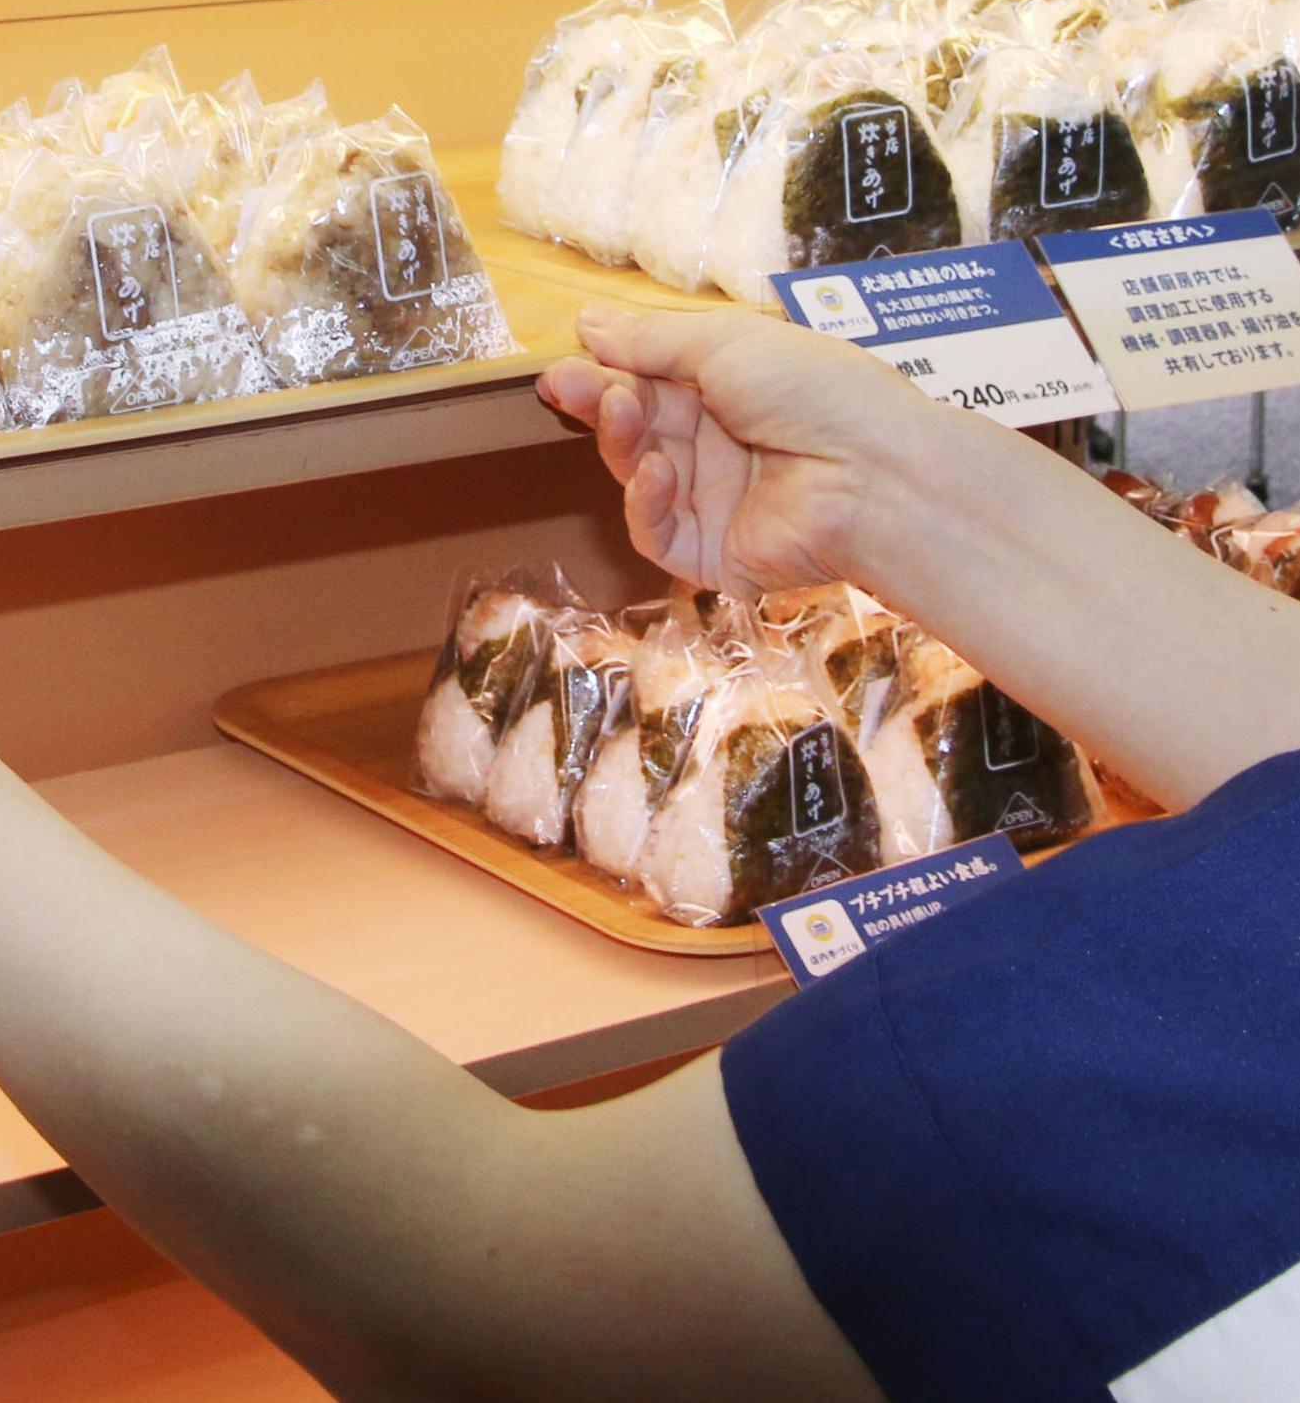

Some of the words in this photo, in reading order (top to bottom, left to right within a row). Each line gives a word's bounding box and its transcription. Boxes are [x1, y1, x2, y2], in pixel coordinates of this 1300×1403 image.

[858, 122, 884, 209] 炊きあげ
[109, 222, 145, 324] 炊きあげ
[1123, 266, 1249, 296] 店舗厨房内では、
[1127, 288, 1274, 324] 調理加工に使用する
[1165, 341, 1294, 375] 共有しております。
[126, 386, 167, 406] OPEN
[811, 868, 841, 888] OPEN
